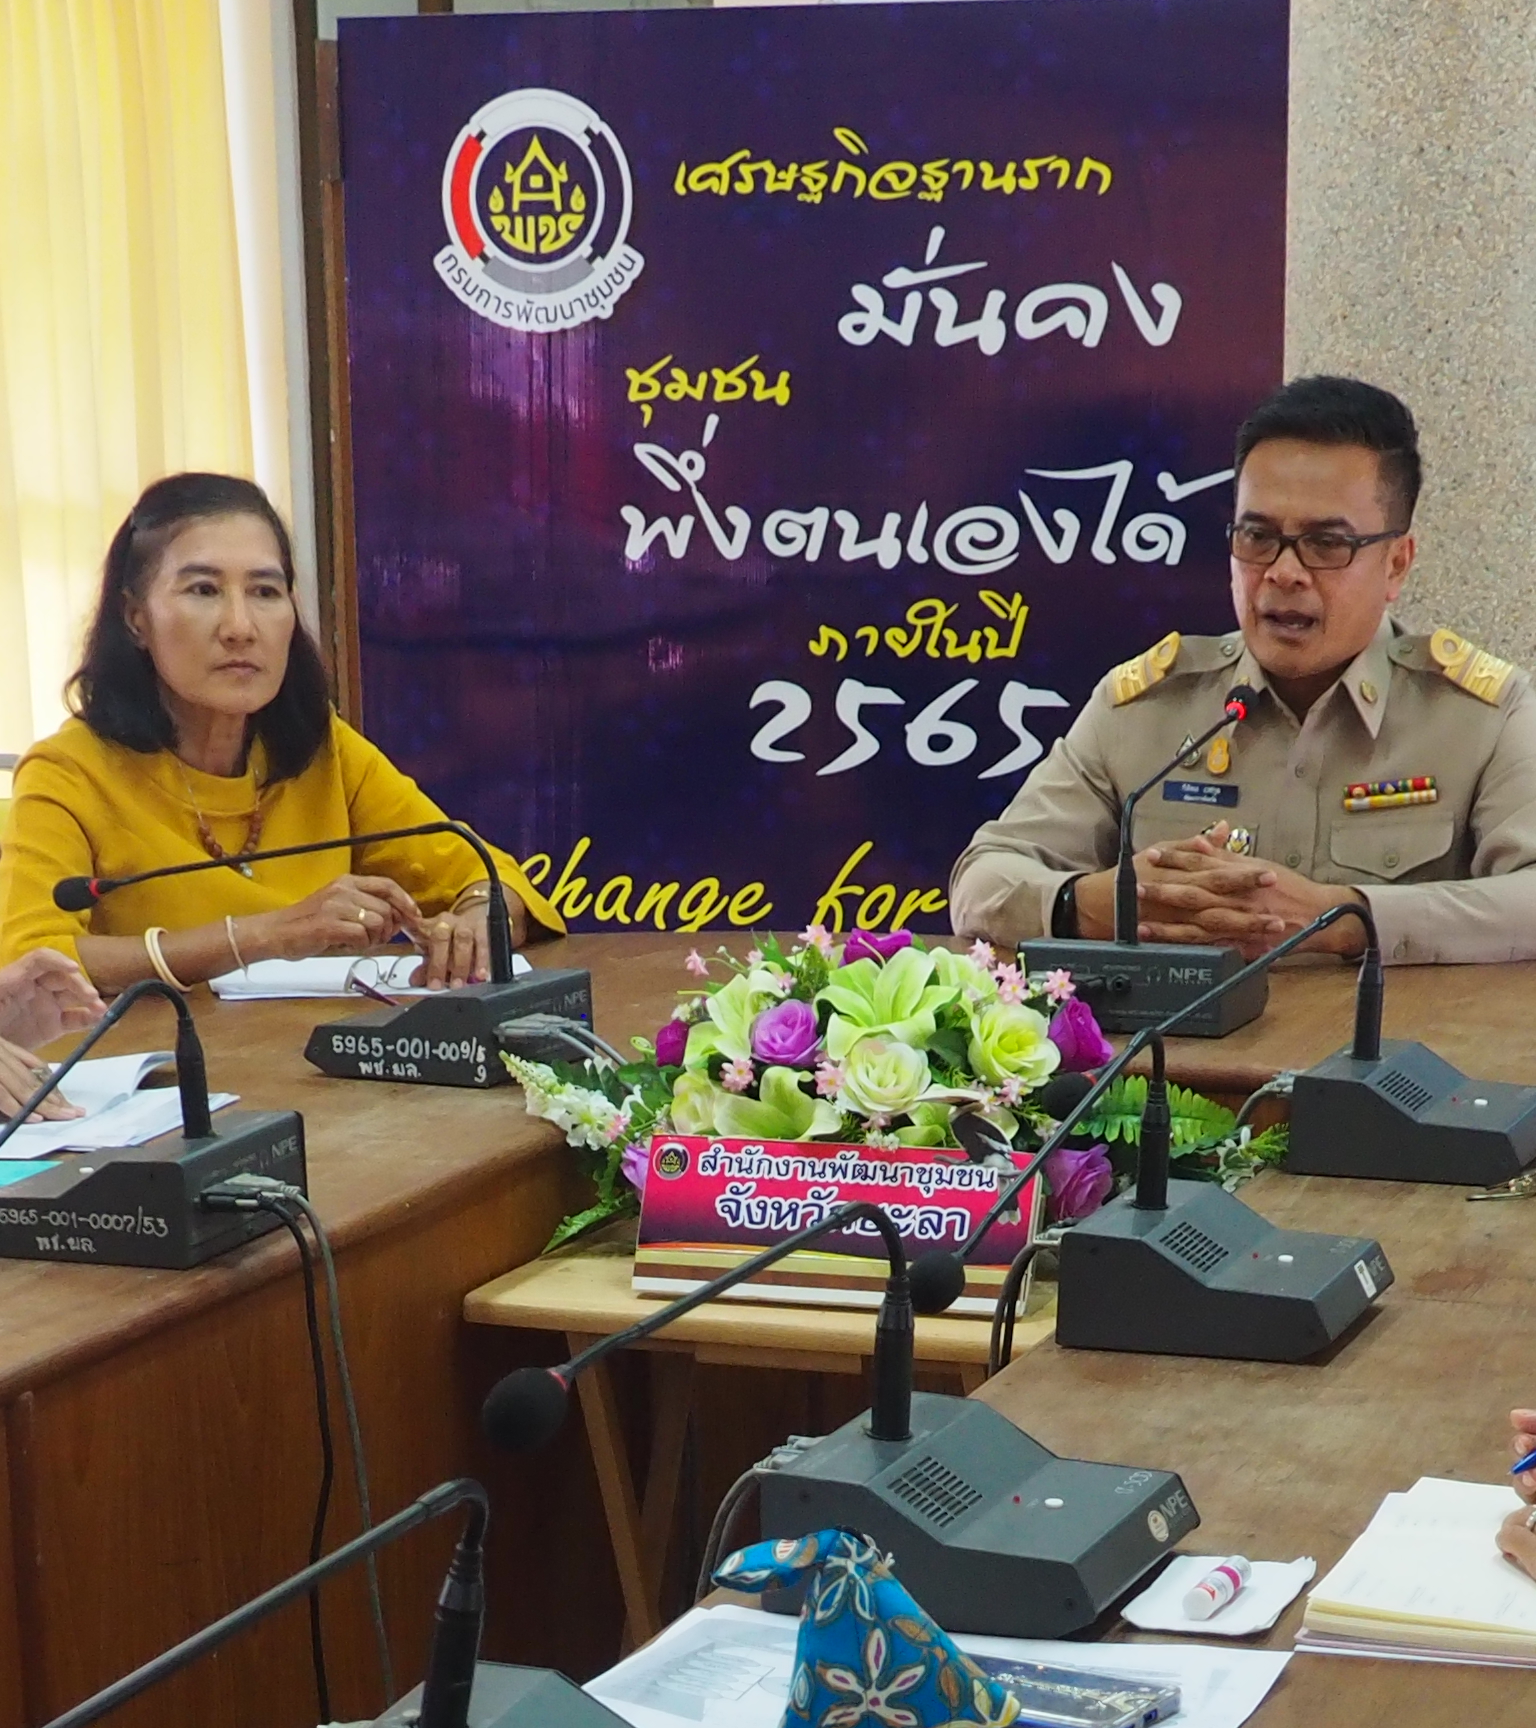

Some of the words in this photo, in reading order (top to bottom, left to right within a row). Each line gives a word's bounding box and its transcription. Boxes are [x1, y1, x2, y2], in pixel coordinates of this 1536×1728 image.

[440, 251, 638, 325] กรมการพัฒนาชุมชน
[837, 224, 1183, 356] มั่นคง
[624, 353, 791, 427] ชุมชน
[620, 413, 1235, 575] พึ่งตนเองได้
[808, 590, 1029, 663] ภายในปี
[748, 678, 1071, 780] 2565
[811, 840, 948, 933] for
[1168, 966, 1213, 982] NPE
[699, 1145, 998, 1198] สำนักงานพัฒนาชุมชน
